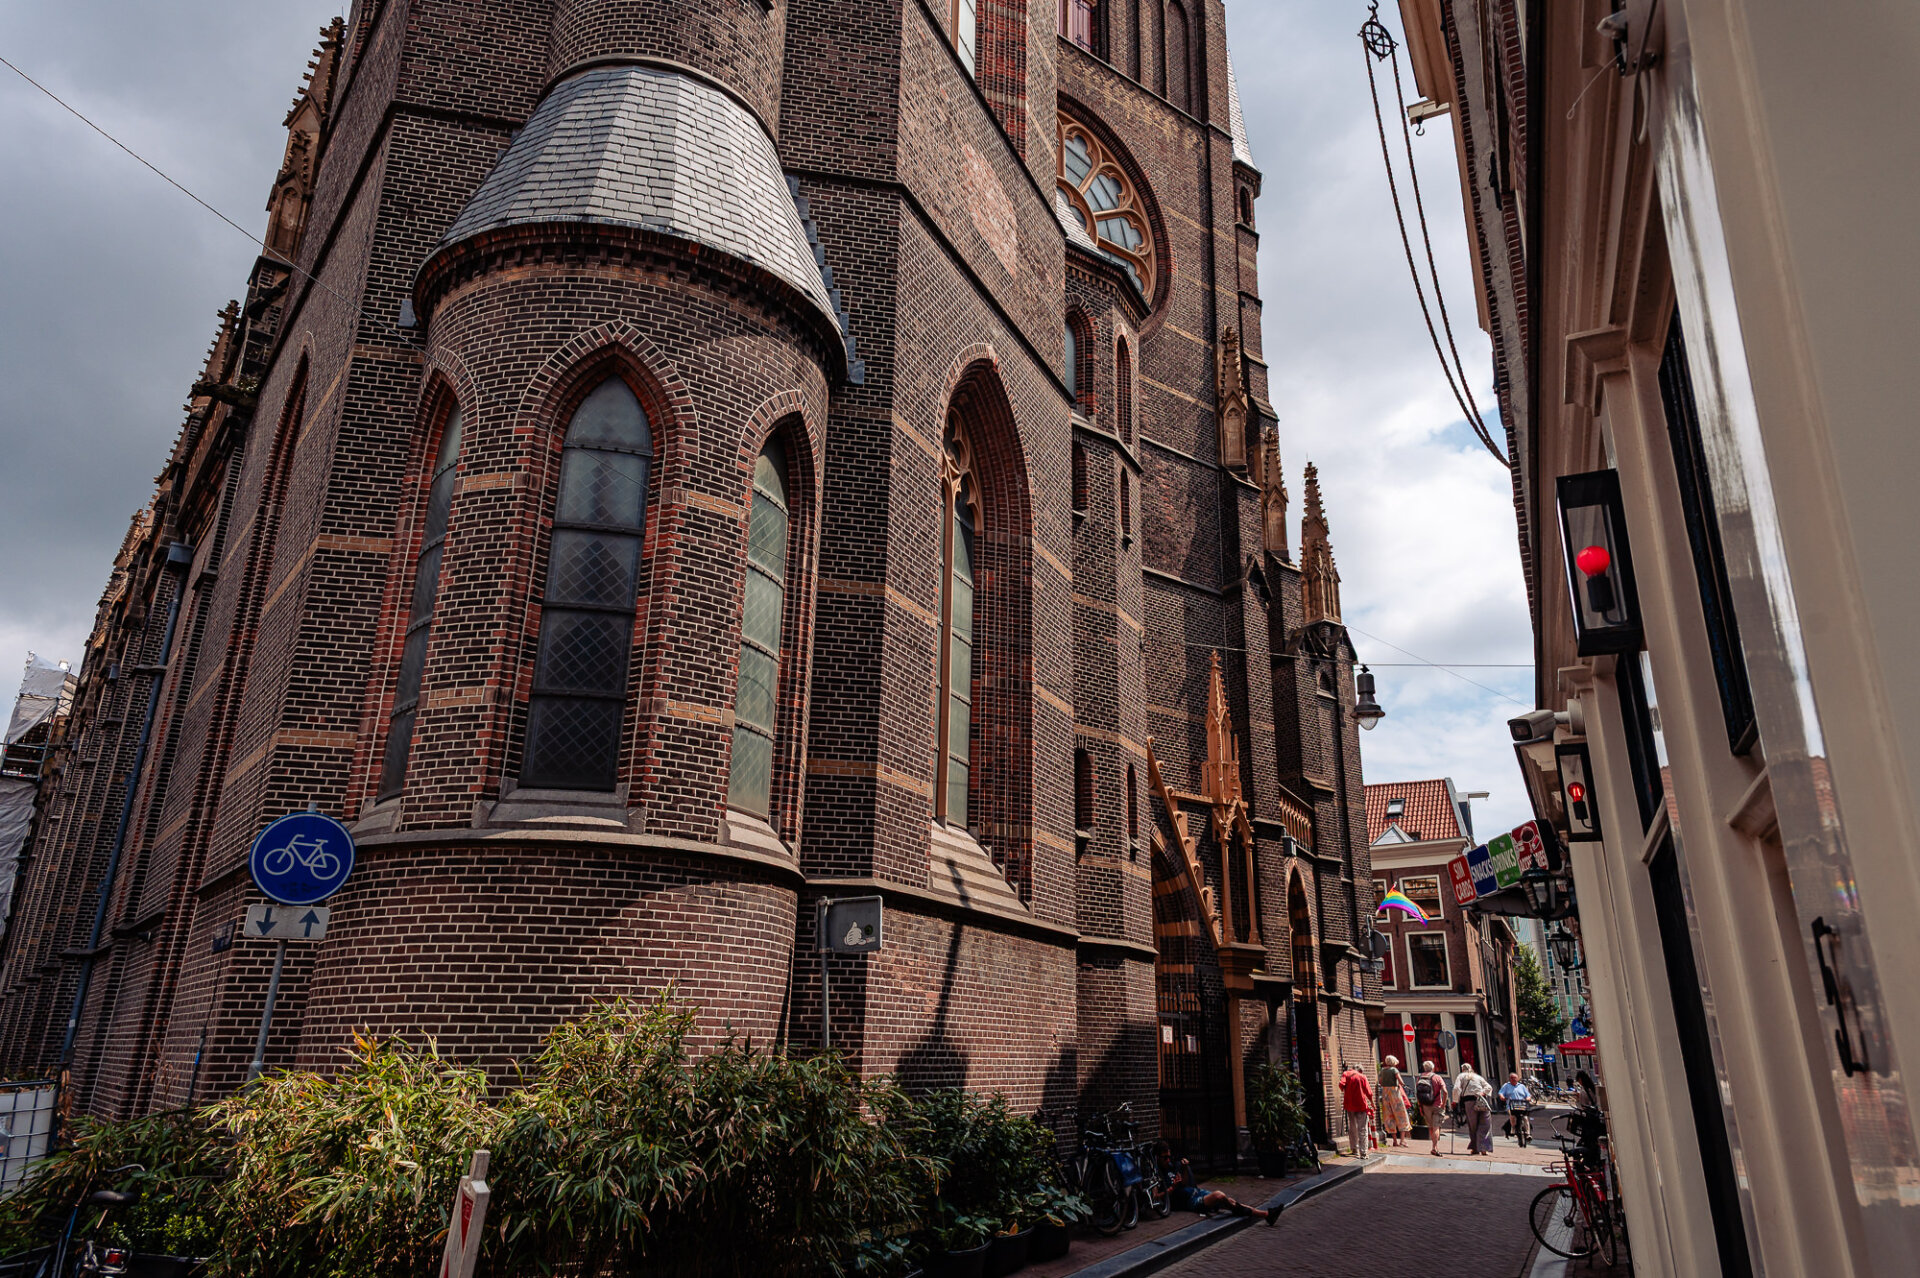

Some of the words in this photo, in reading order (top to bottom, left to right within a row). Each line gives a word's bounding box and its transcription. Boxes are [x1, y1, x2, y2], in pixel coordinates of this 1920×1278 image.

[1453, 861, 1465, 880] SIM
[1470, 858, 1494, 883] SNACKS
[1491, 848, 1517, 873] DRINKS
[1455, 879, 1474, 900] CARDS
